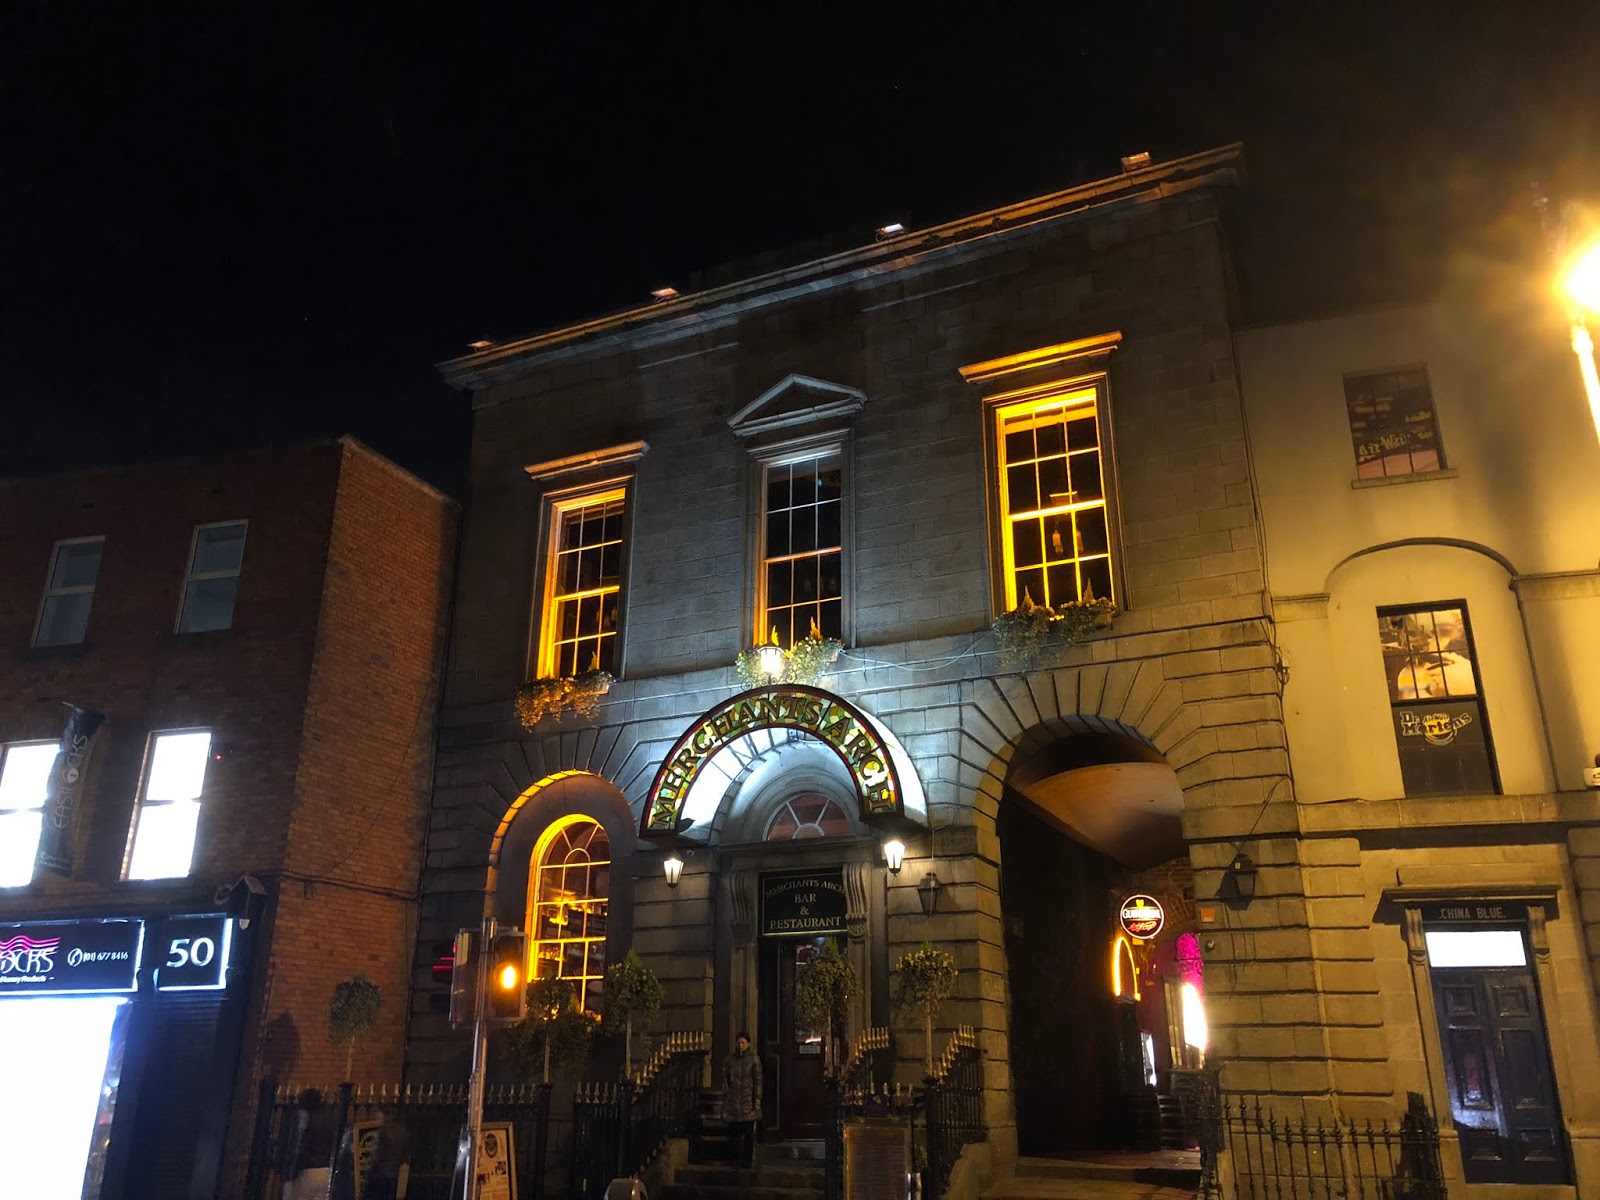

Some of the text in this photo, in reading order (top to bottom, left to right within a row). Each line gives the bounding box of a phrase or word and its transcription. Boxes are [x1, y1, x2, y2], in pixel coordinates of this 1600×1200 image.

[651, 693, 892, 829] MERCHANTS ARCH
[765, 879, 846, 899] MERCHANTS ARCH
[794, 892, 817, 904] BAR
[799, 905, 810, 916] &
[1440, 907, 1471, 920] CHINA
[769, 916, 842, 930] RESTAURANT
[96, 951, 110, 961] 677
[166, 936, 215, 968] 50
